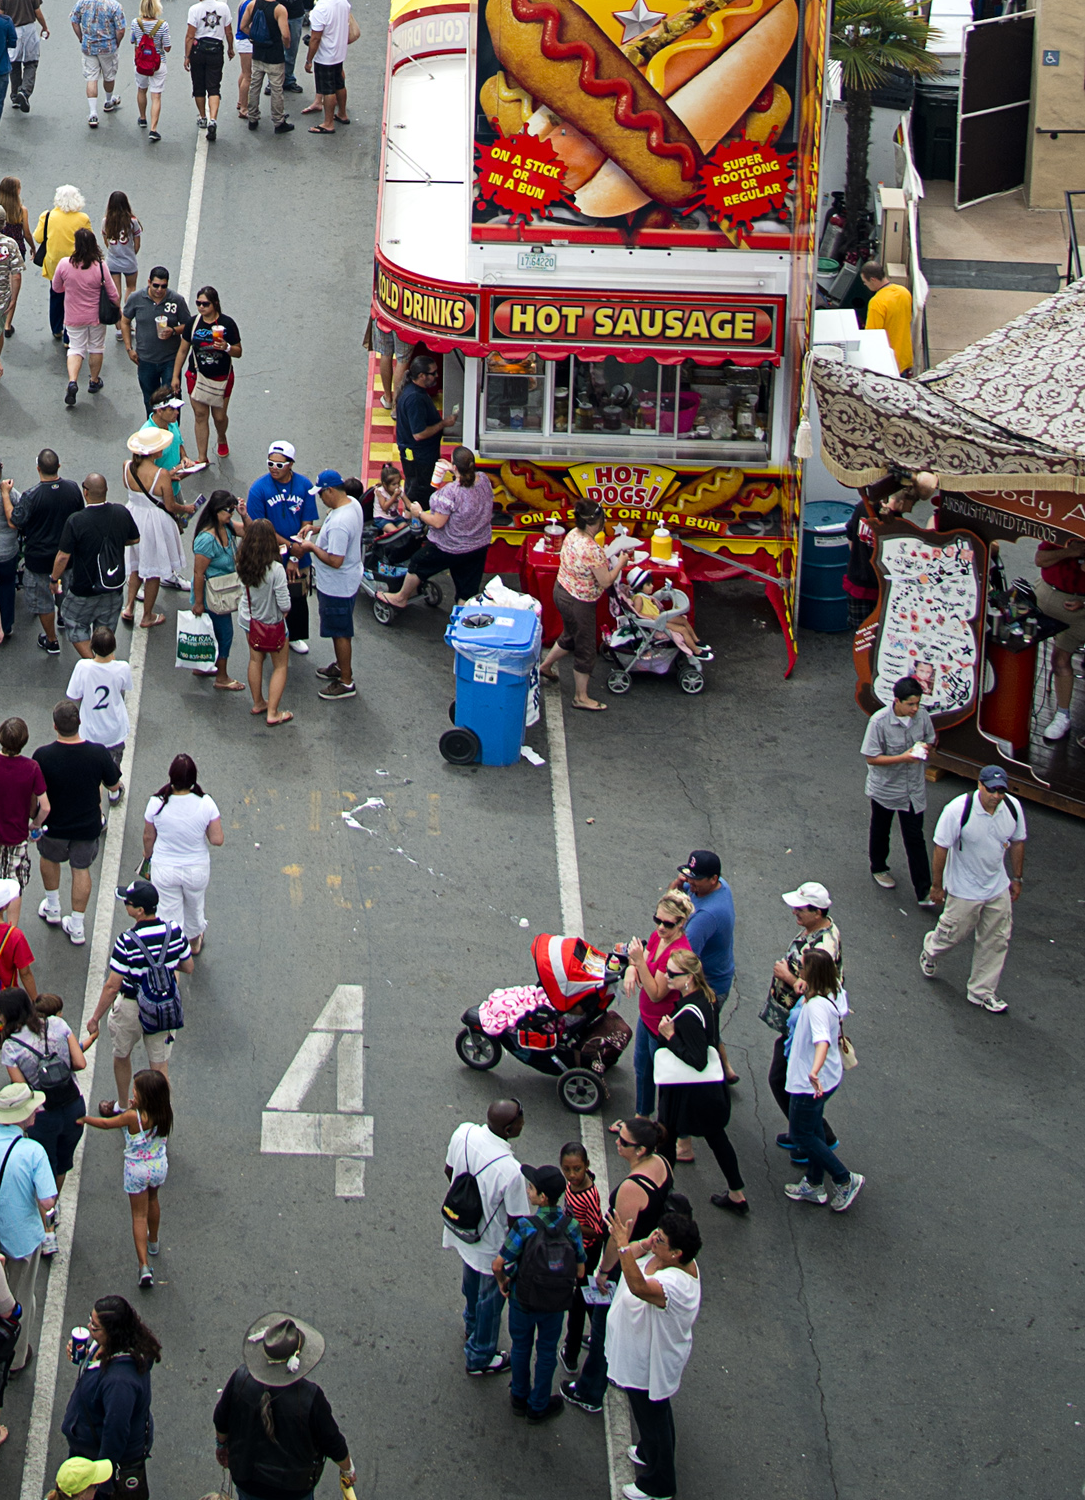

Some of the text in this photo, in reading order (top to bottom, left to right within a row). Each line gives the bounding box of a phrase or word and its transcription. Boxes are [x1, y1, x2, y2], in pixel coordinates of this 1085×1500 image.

[491, 147, 560, 179] ON A STICK
[513, 167, 529, 182] OR
[713, 160, 780, 187] FOOTLONG
[723, 153, 763, 173] SUPER
[488, 172, 546, 200] IN A BUN
[723, 183, 782, 207] REGULAR
[741, 177, 758, 190] OR
[164, 302, 178, 314] 33
[402, 291, 465, 330] DRINKS
[511, 305, 755, 341] HOT SAUSAGE
[594, 464, 652, 488] HOT
[587, 484, 662, 510] DOGS!
[520, 509, 721, 533] ON A OR IN A BUN
[981, 505, 1017, 530] PAINTED
[1016, 515, 1058, 544] TATTOOS
[92, 685, 110, 711] 2
[260, 984, 374, 1197] 4
